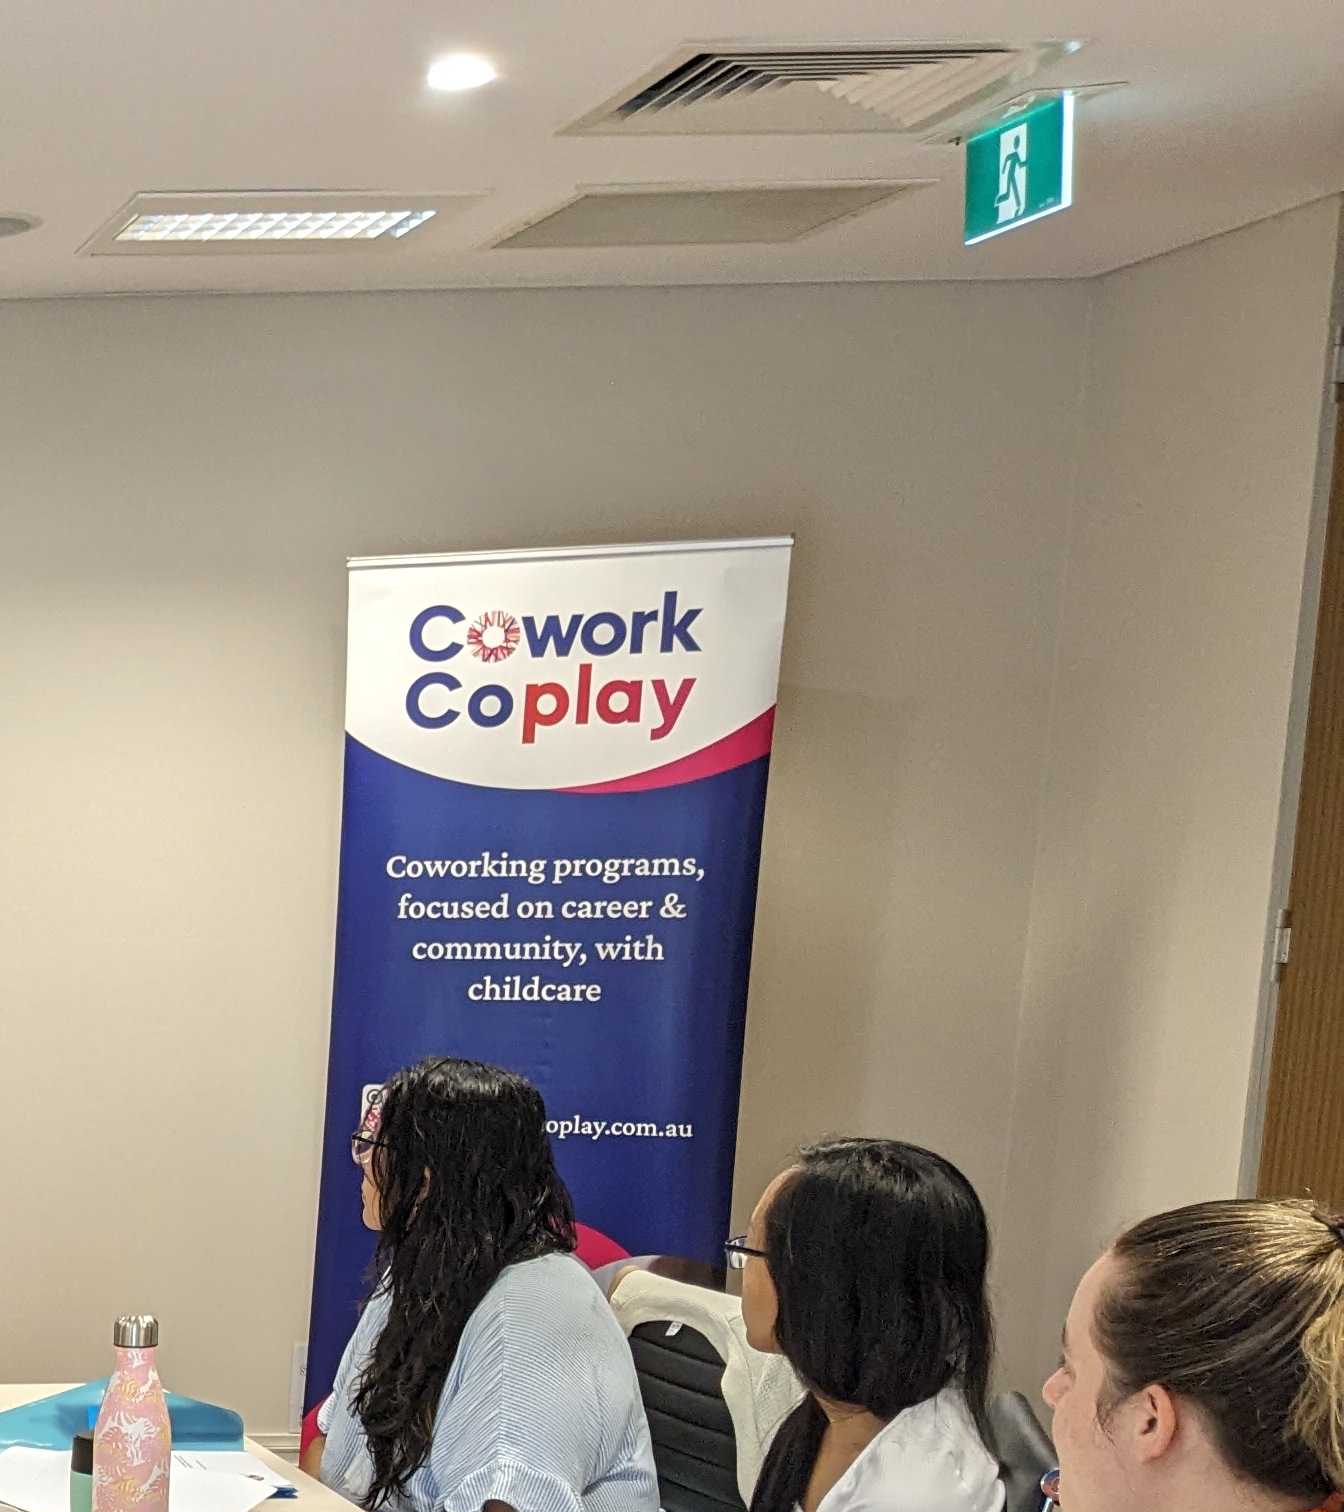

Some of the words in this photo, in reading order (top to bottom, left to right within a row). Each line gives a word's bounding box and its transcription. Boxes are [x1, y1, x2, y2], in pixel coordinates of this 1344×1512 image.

[408, 590, 704, 663] Cowork
[405, 663, 697, 744] Coplay
[386, 853, 546, 885] Coworking
[552, 856, 706, 884] programs,
[397, 893, 509, 921] focused
[516, 899, 554, 920] on
[561, 898, 653, 920] career
[659, 892, 687, 920] &
[412, 935, 588, 967] community,
[595, 934, 664, 962] with
[467, 976, 602, 1002] childcare
[542, 1114, 693, 1141] oplay.com.au
